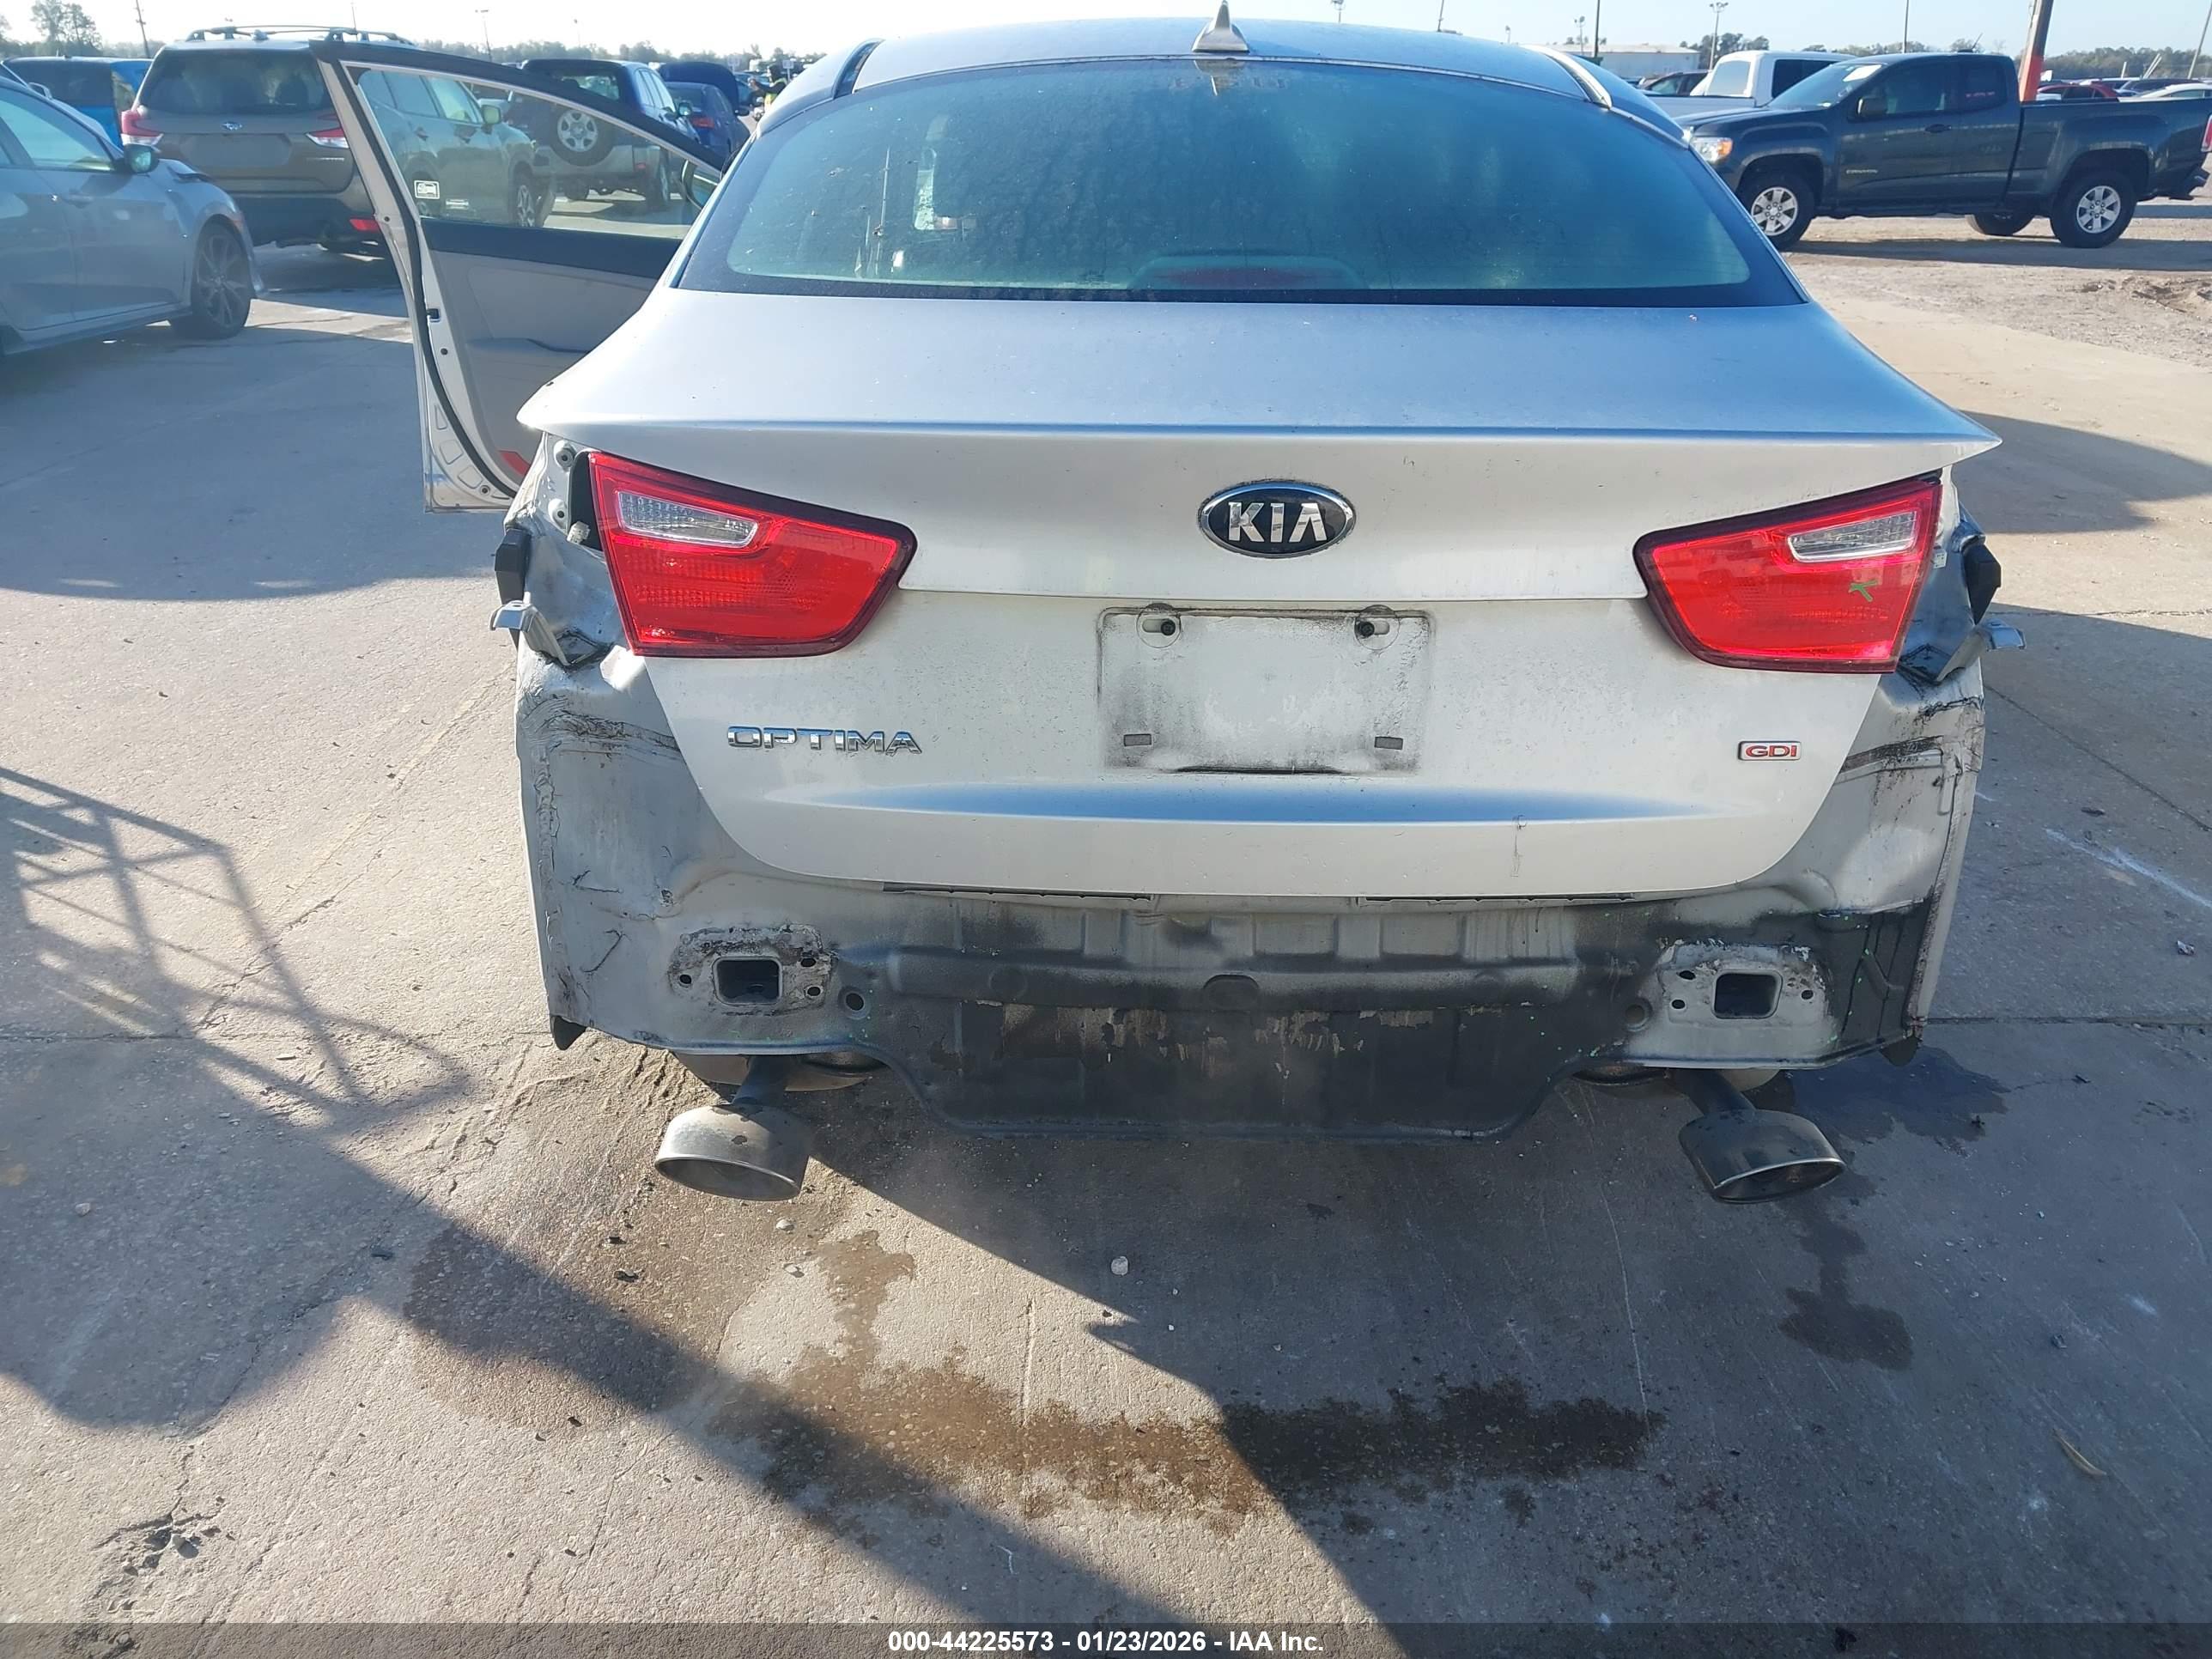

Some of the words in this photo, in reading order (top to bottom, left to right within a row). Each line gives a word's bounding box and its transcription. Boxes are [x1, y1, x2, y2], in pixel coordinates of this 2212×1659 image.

[1228, 501, 1328, 543] KIA
[727, 726, 922, 757] OPTIMA
[1745, 744, 1797, 757] GDI
